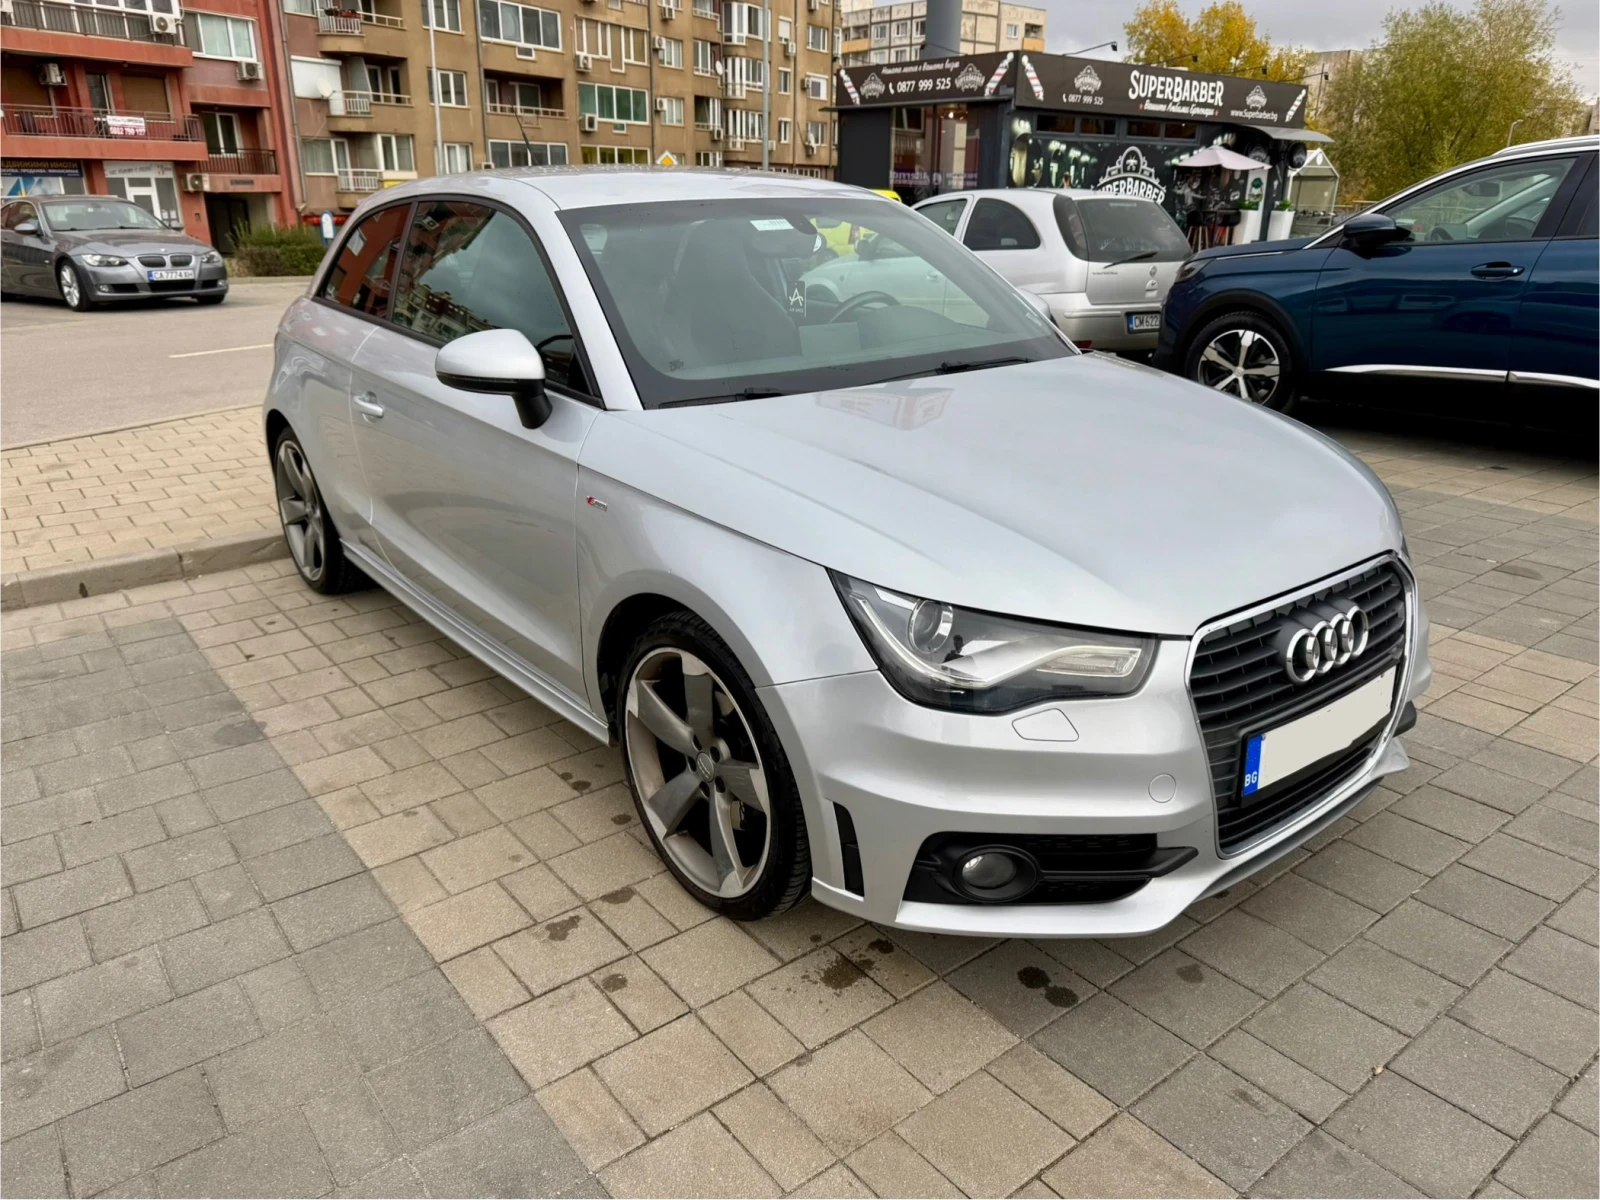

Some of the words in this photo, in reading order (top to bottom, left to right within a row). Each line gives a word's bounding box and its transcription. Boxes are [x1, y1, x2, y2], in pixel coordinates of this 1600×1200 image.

[896, 80, 916, 94] 0877
[918, 79, 933, 91] 999
[936, 77, 952, 90] 525
[1068, 94, 1082, 103] 0877
[1082, 95, 1093, 104] 999
[1093, 96, 1104, 105] 525
[1101, 177, 1166, 205] PERBARBER
[1145, 315, 1160, 328] 622
[1244, 770, 1258, 788] BG
